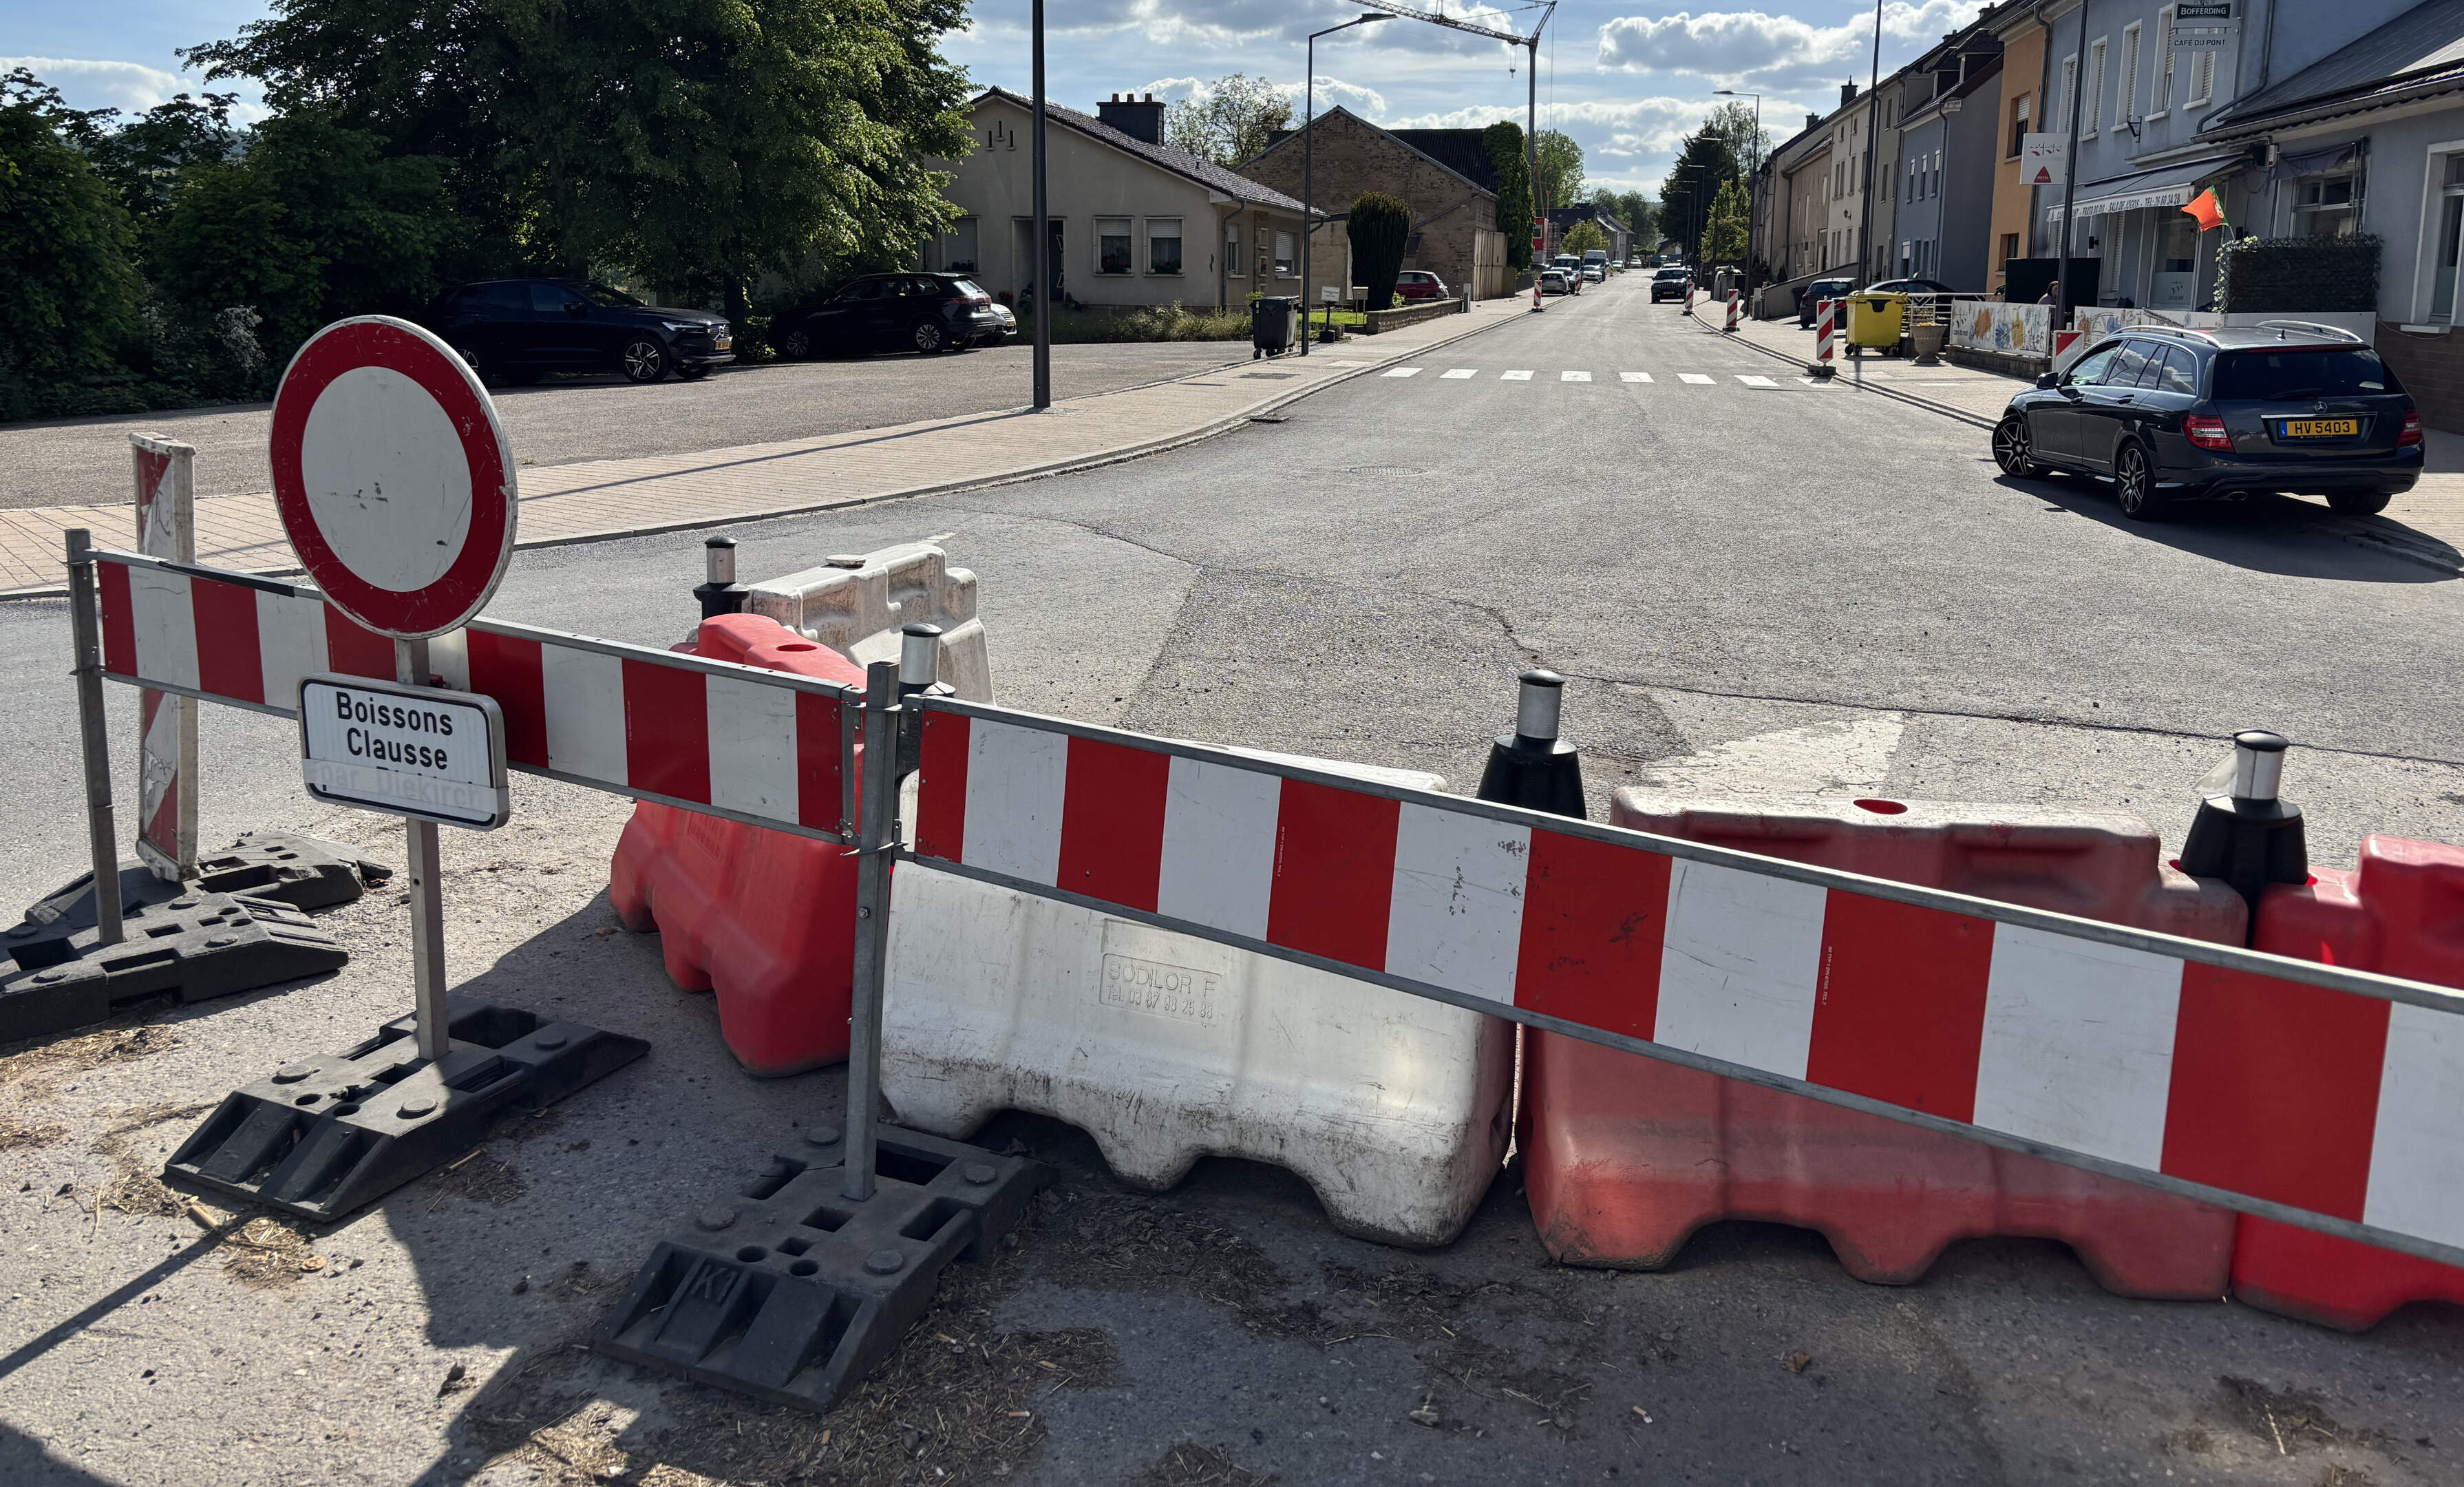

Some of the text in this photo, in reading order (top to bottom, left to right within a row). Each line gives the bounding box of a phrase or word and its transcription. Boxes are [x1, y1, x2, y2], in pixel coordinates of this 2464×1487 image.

[2295, 421, 2350, 434] HV 5403
[336, 691, 453, 736] Boissons
[347, 727, 447, 770] Clausse
[1107, 962, 1216, 998] SODILOR F
[1128, 987, 1142, 1005] 03
[1146, 991, 1160, 1009] 87
[1182, 998, 1195, 1015] 25
